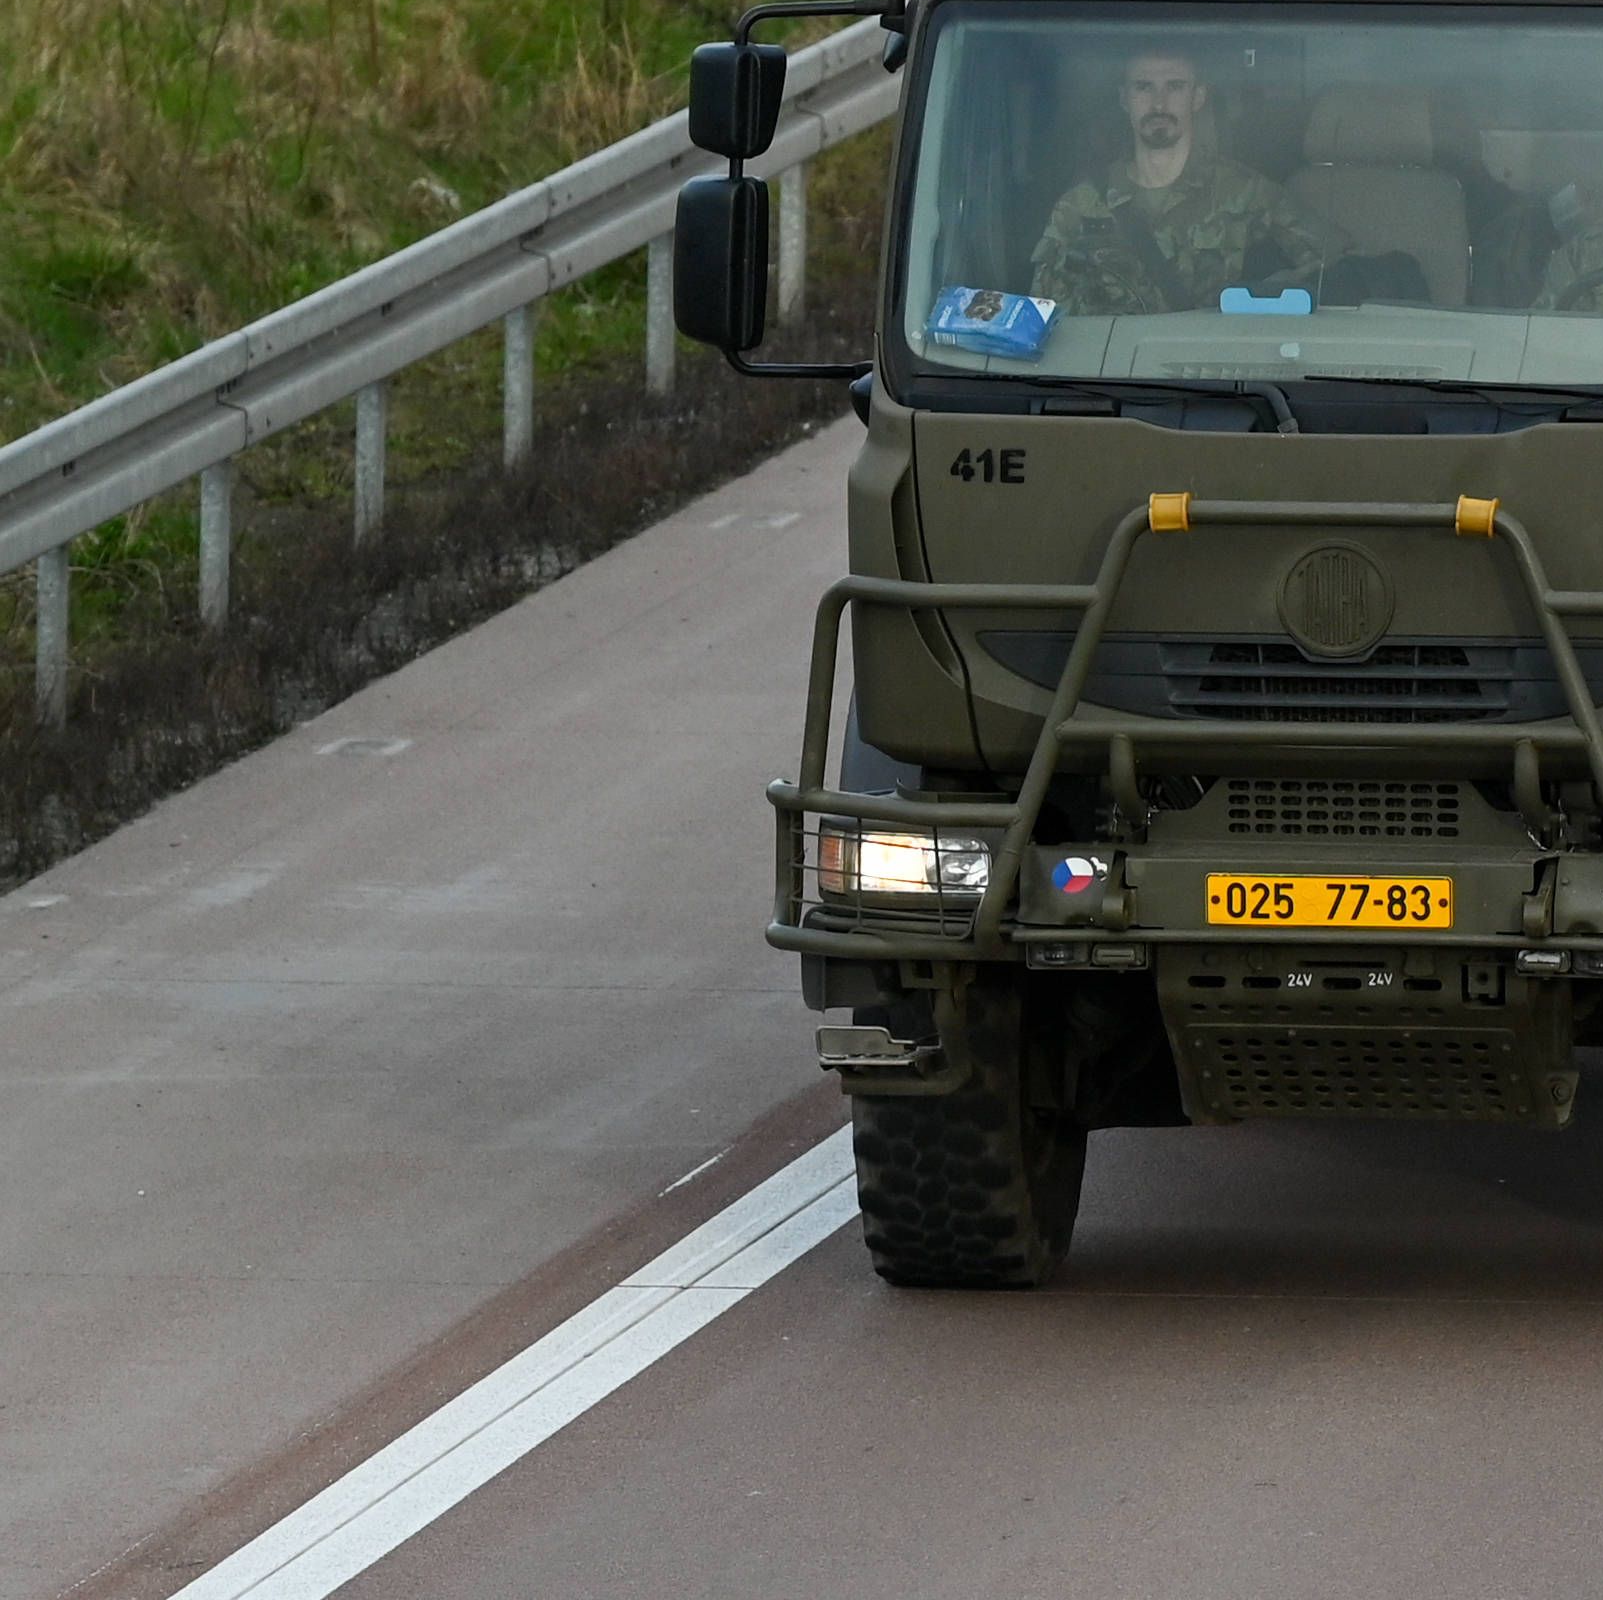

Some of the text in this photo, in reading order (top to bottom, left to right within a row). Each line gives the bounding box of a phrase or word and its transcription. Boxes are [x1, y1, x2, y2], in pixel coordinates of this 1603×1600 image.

[950, 448, 1026, 484] 41E
[1226, 882, 1432, 921] 025 77-83
[1287, 973, 1313, 988] 24V
[1368, 972, 1394, 987] 24V
